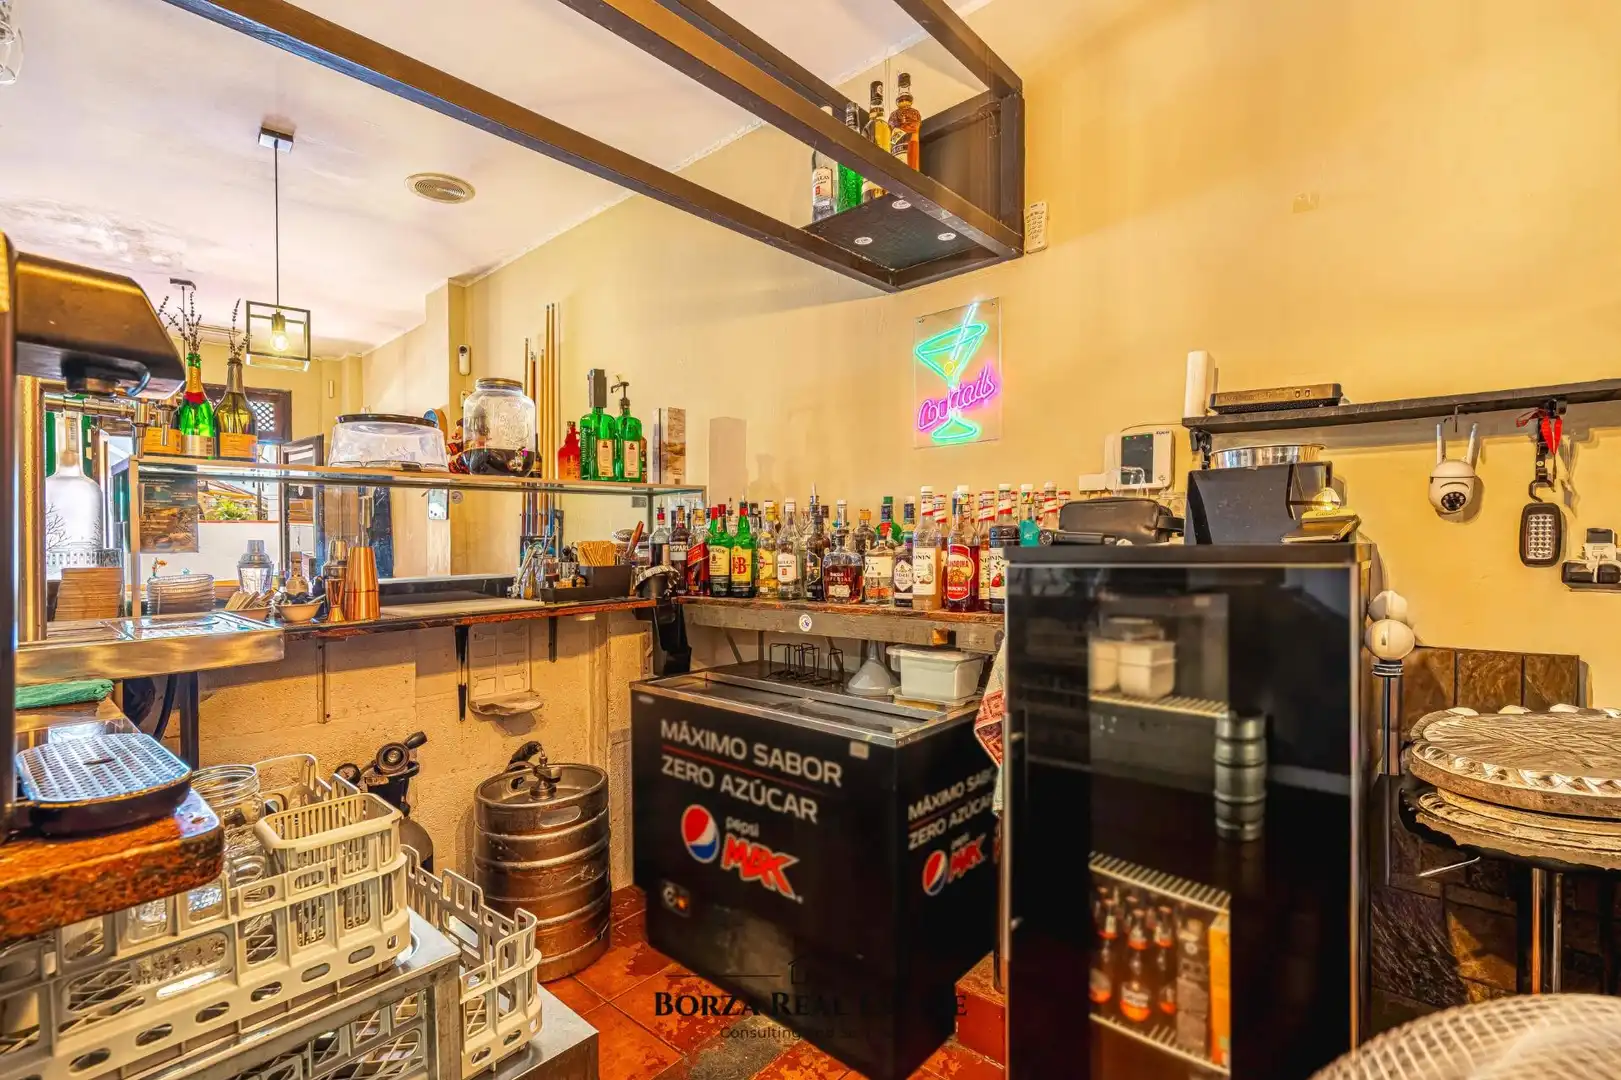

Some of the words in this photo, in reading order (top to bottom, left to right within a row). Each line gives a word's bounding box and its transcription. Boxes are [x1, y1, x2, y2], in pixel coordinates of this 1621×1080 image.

[660, 718, 747, 760] MÁXIMO
[753, 743, 843, 788] SABOR
[661, 755, 714, 788] ZERO
[720, 773, 818, 825] AZÚCAR
[725, 816, 759, 837] pepsi
[908, 818, 947, 851] ZERO
[720, 832, 800, 900] MAX
